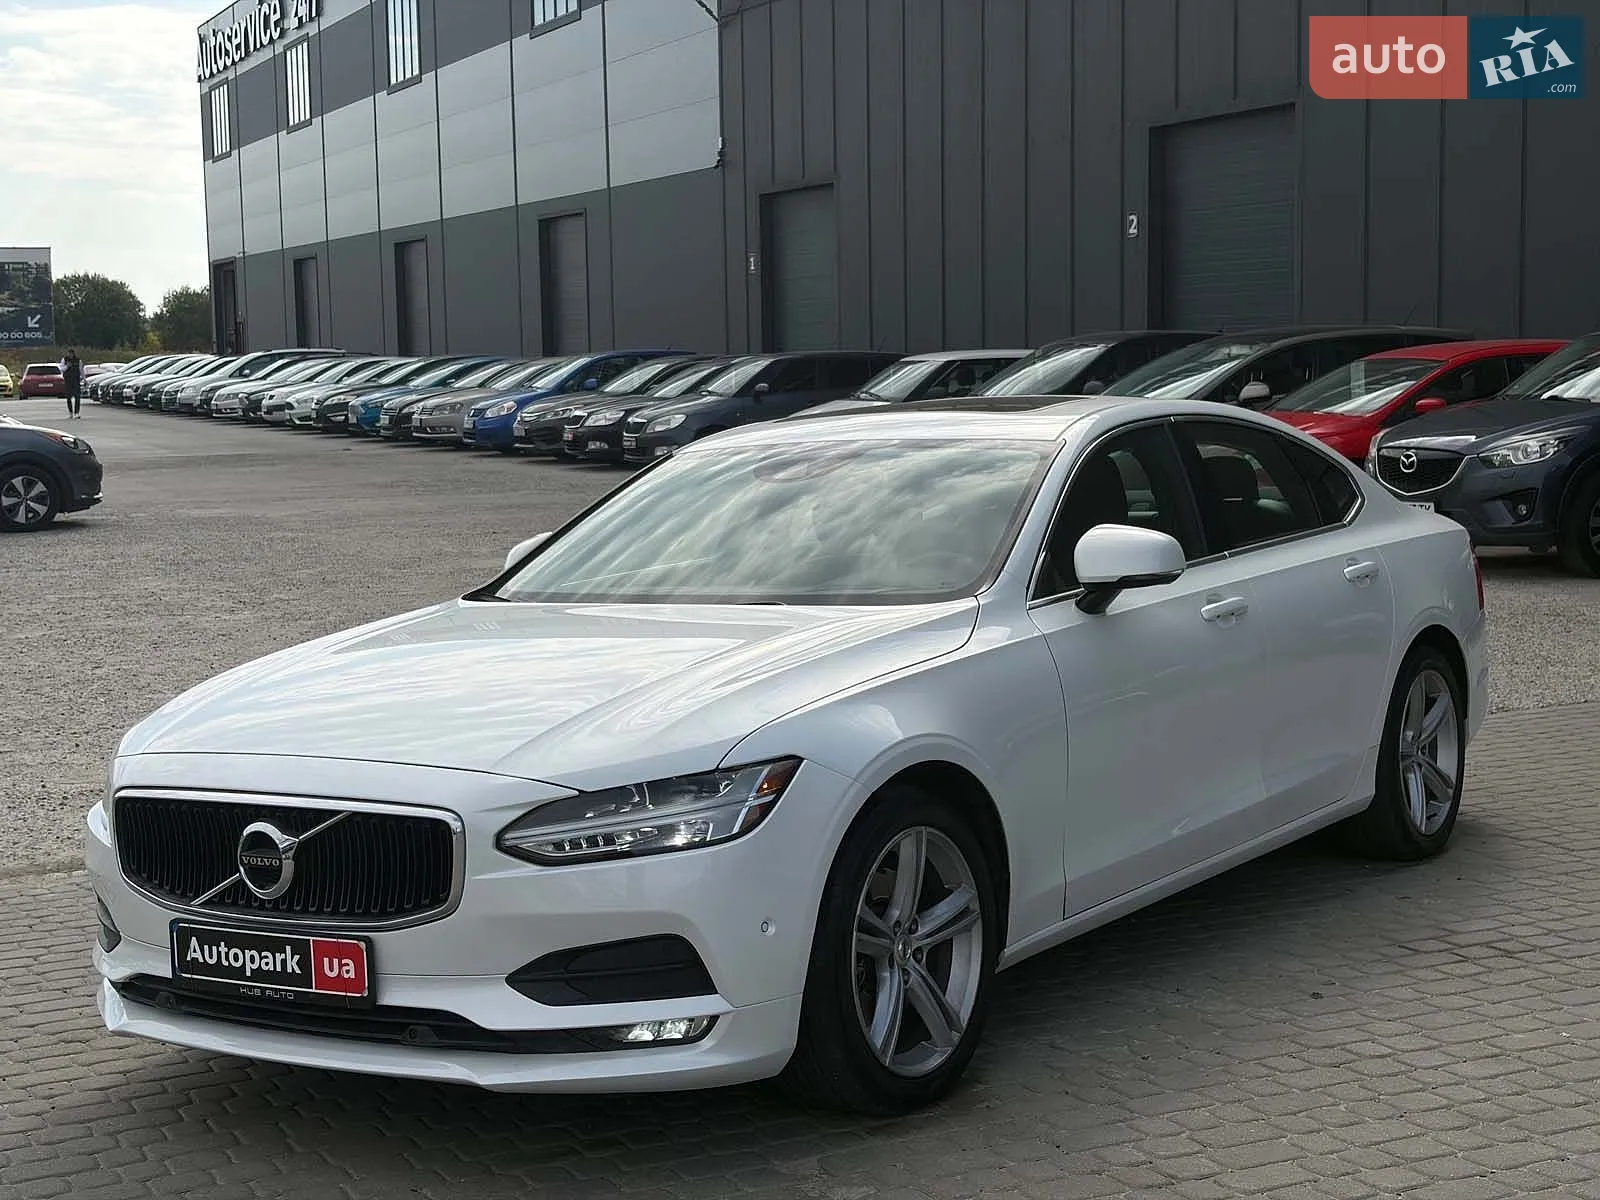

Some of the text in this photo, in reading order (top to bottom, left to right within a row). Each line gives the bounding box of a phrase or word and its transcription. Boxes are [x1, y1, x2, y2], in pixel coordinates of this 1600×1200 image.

[198, 0, 281, 80] Autoservice
[1128, 215, 1138, 234] 2
[242, 855, 280, 866] VOLVO
[186, 936, 356, 979] Autopark ua
[240, 986, 294, 999] HUB AUTO
